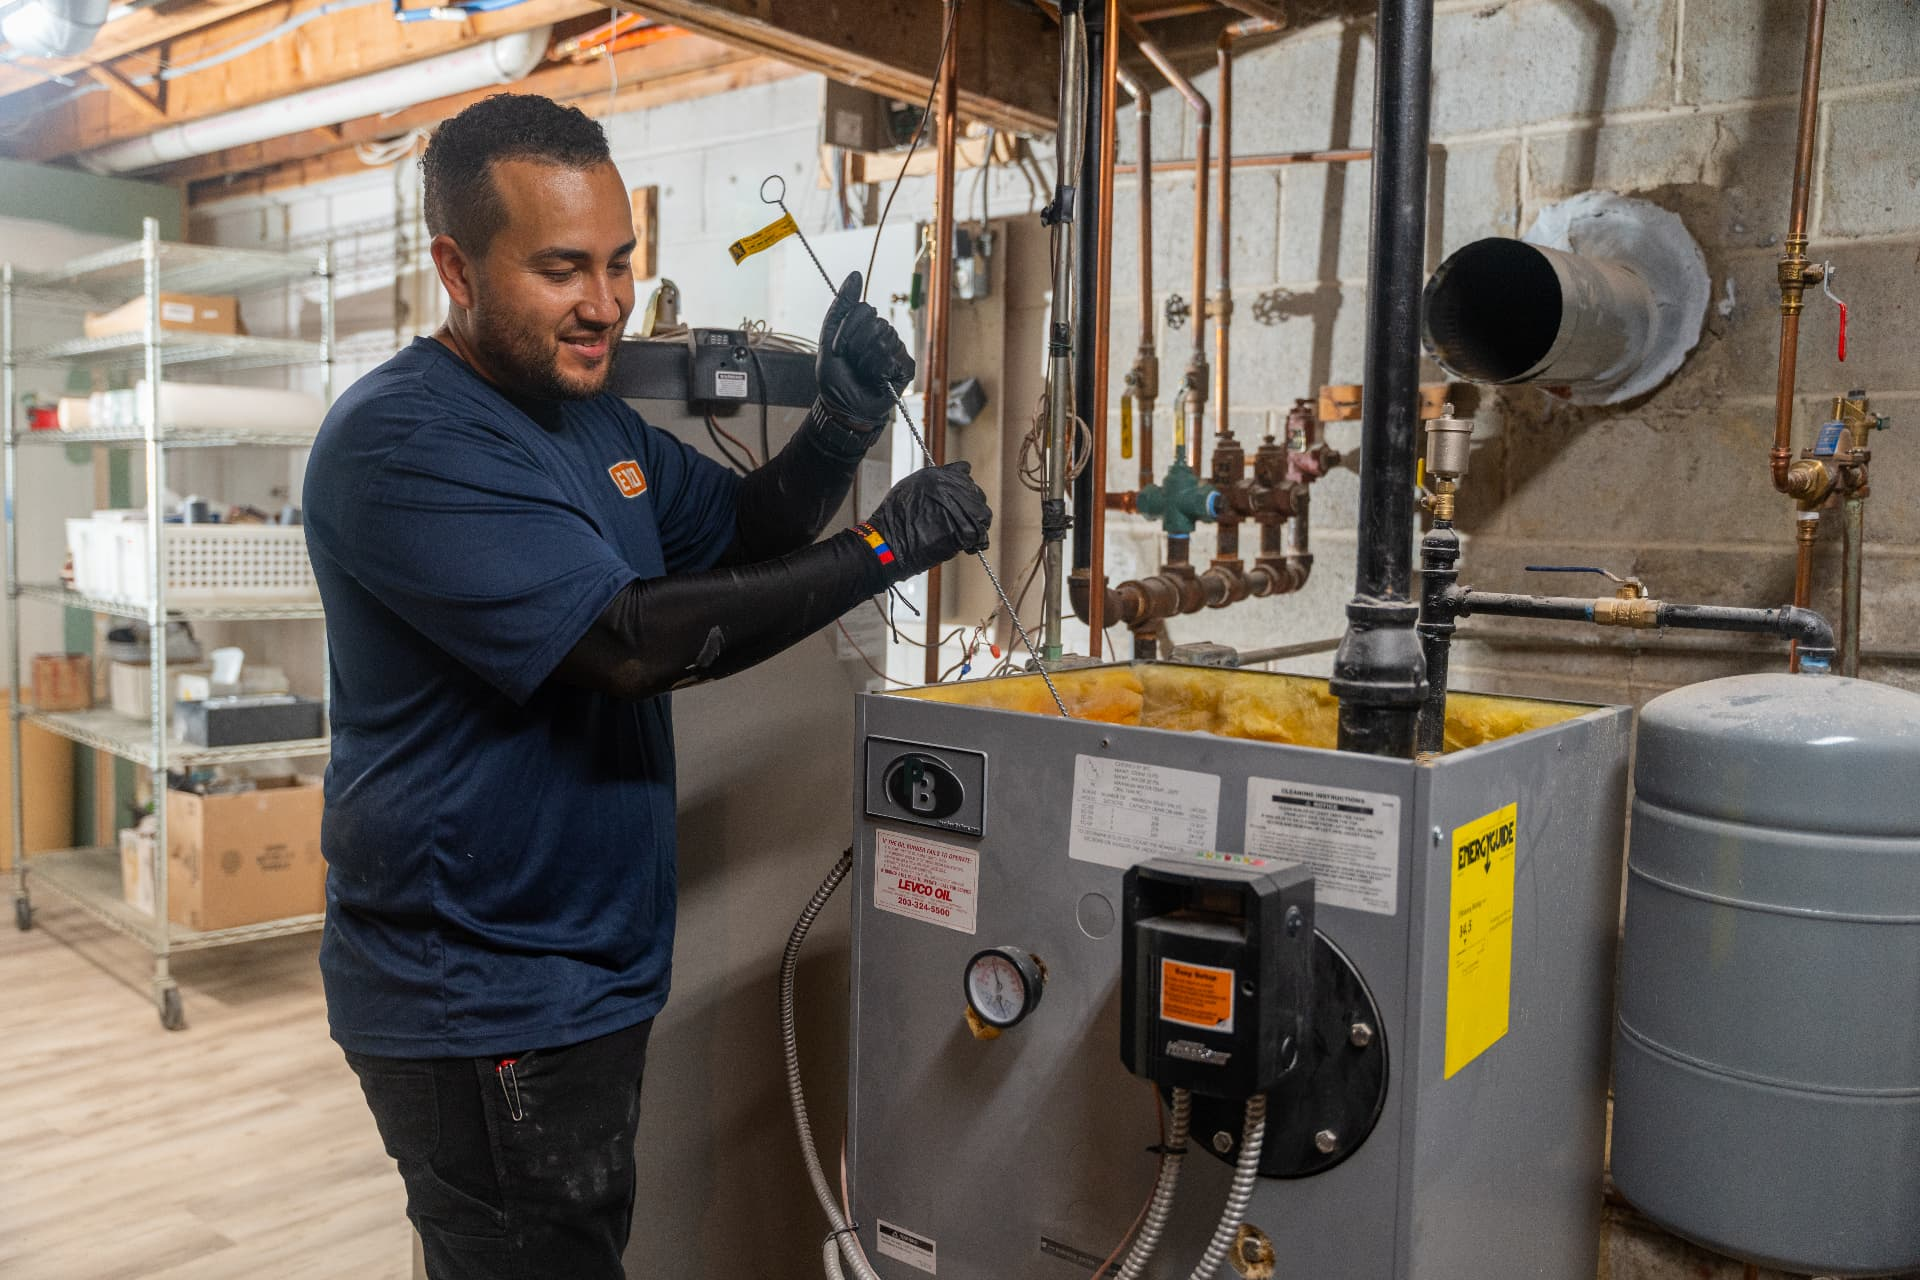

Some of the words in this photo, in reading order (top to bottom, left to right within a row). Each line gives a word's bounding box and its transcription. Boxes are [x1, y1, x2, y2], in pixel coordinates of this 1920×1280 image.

[898, 878, 933, 896] LEVCO
[935, 888, 953, 902] OIL
[898, 896, 950, 917] 203-324-5500
